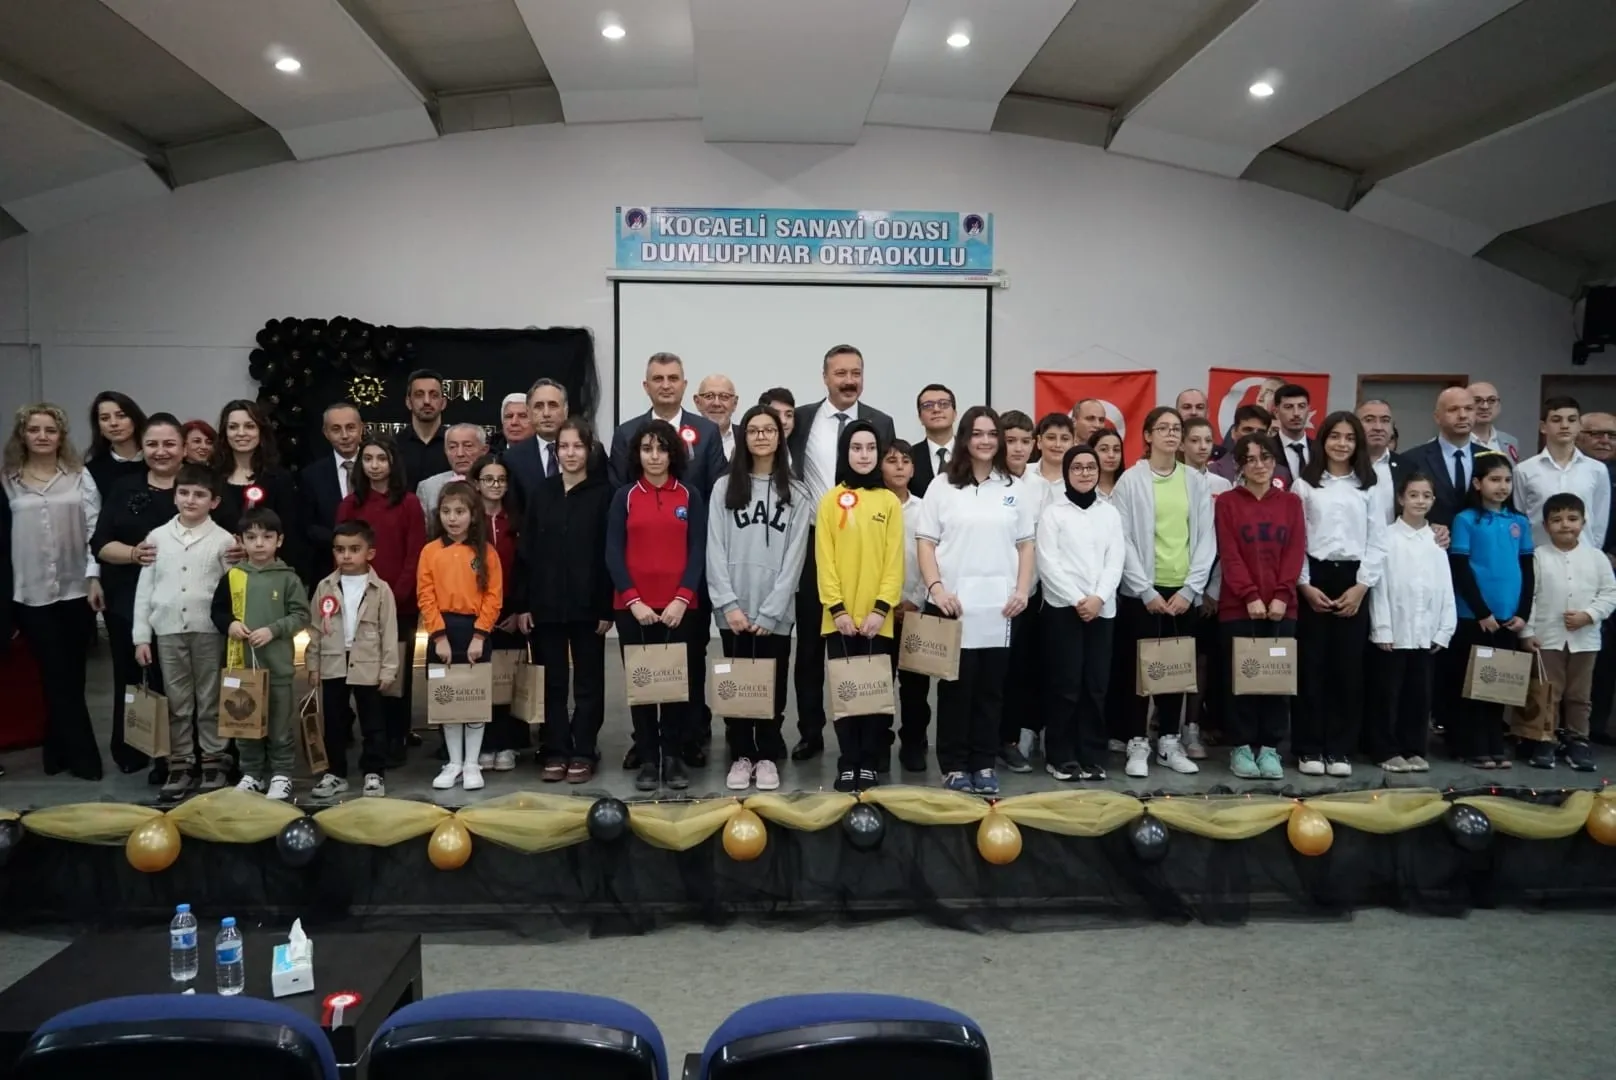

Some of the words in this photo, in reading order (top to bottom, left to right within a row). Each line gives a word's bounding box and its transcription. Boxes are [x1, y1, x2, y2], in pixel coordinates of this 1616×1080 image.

[659, 213, 767, 238] KOCAELİ
[775, 216, 865, 240] SANAYİ
[873, 220, 949, 241] ODASI
[641, 243, 811, 264] DUMLUPINAR
[818, 245, 967, 267] ORTAOKULU
[356, 383, 377, 397] 24
[733, 500, 787, 533] GAL
